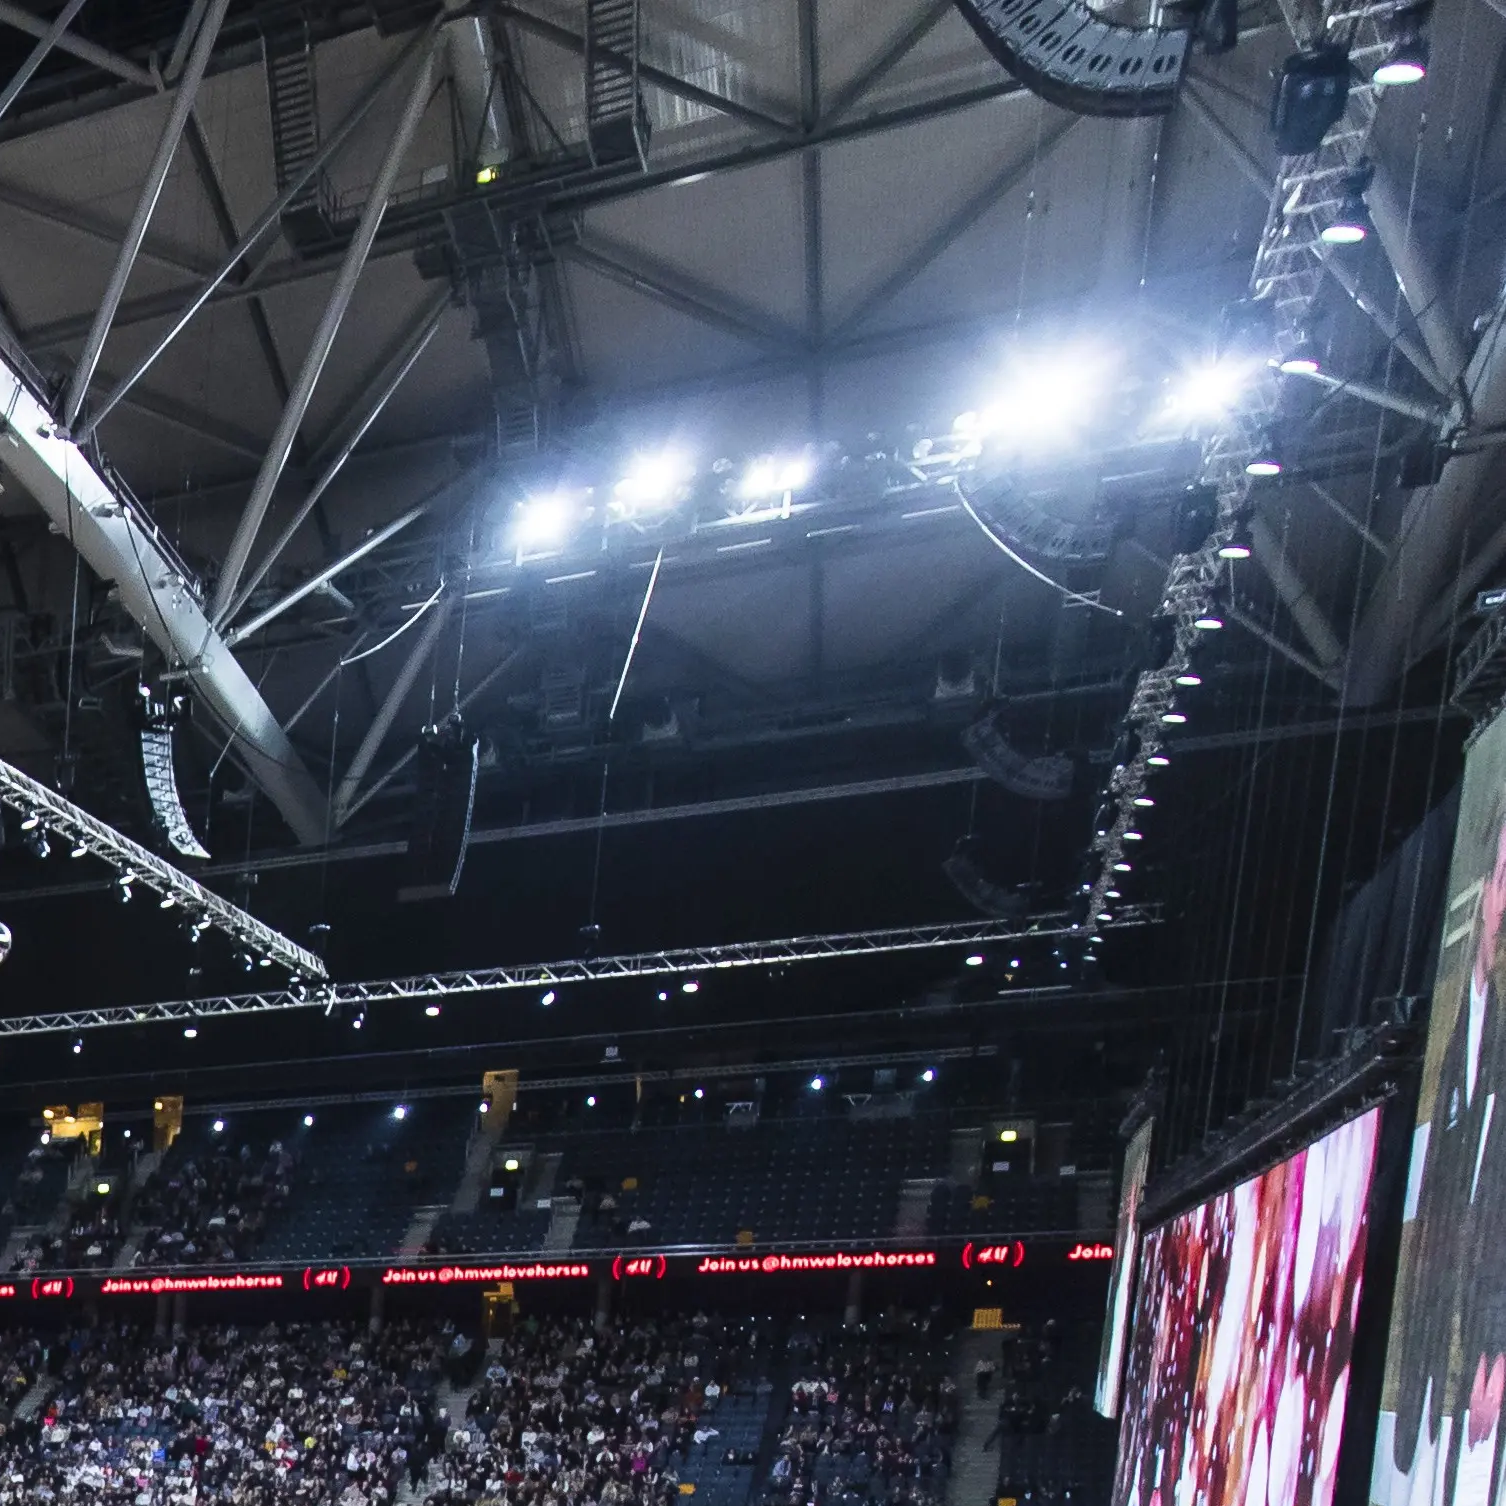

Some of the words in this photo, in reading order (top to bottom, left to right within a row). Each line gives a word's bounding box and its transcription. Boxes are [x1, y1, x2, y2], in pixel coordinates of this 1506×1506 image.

[1067, 1243, 1113, 1261] Join
[697, 1257, 737, 1273] Join
[737, 1258, 761, 1272] us
[382, 1268, 417, 1284] Join
[417, 1269, 438, 1283] us
[101, 1278, 133, 1294] Join
